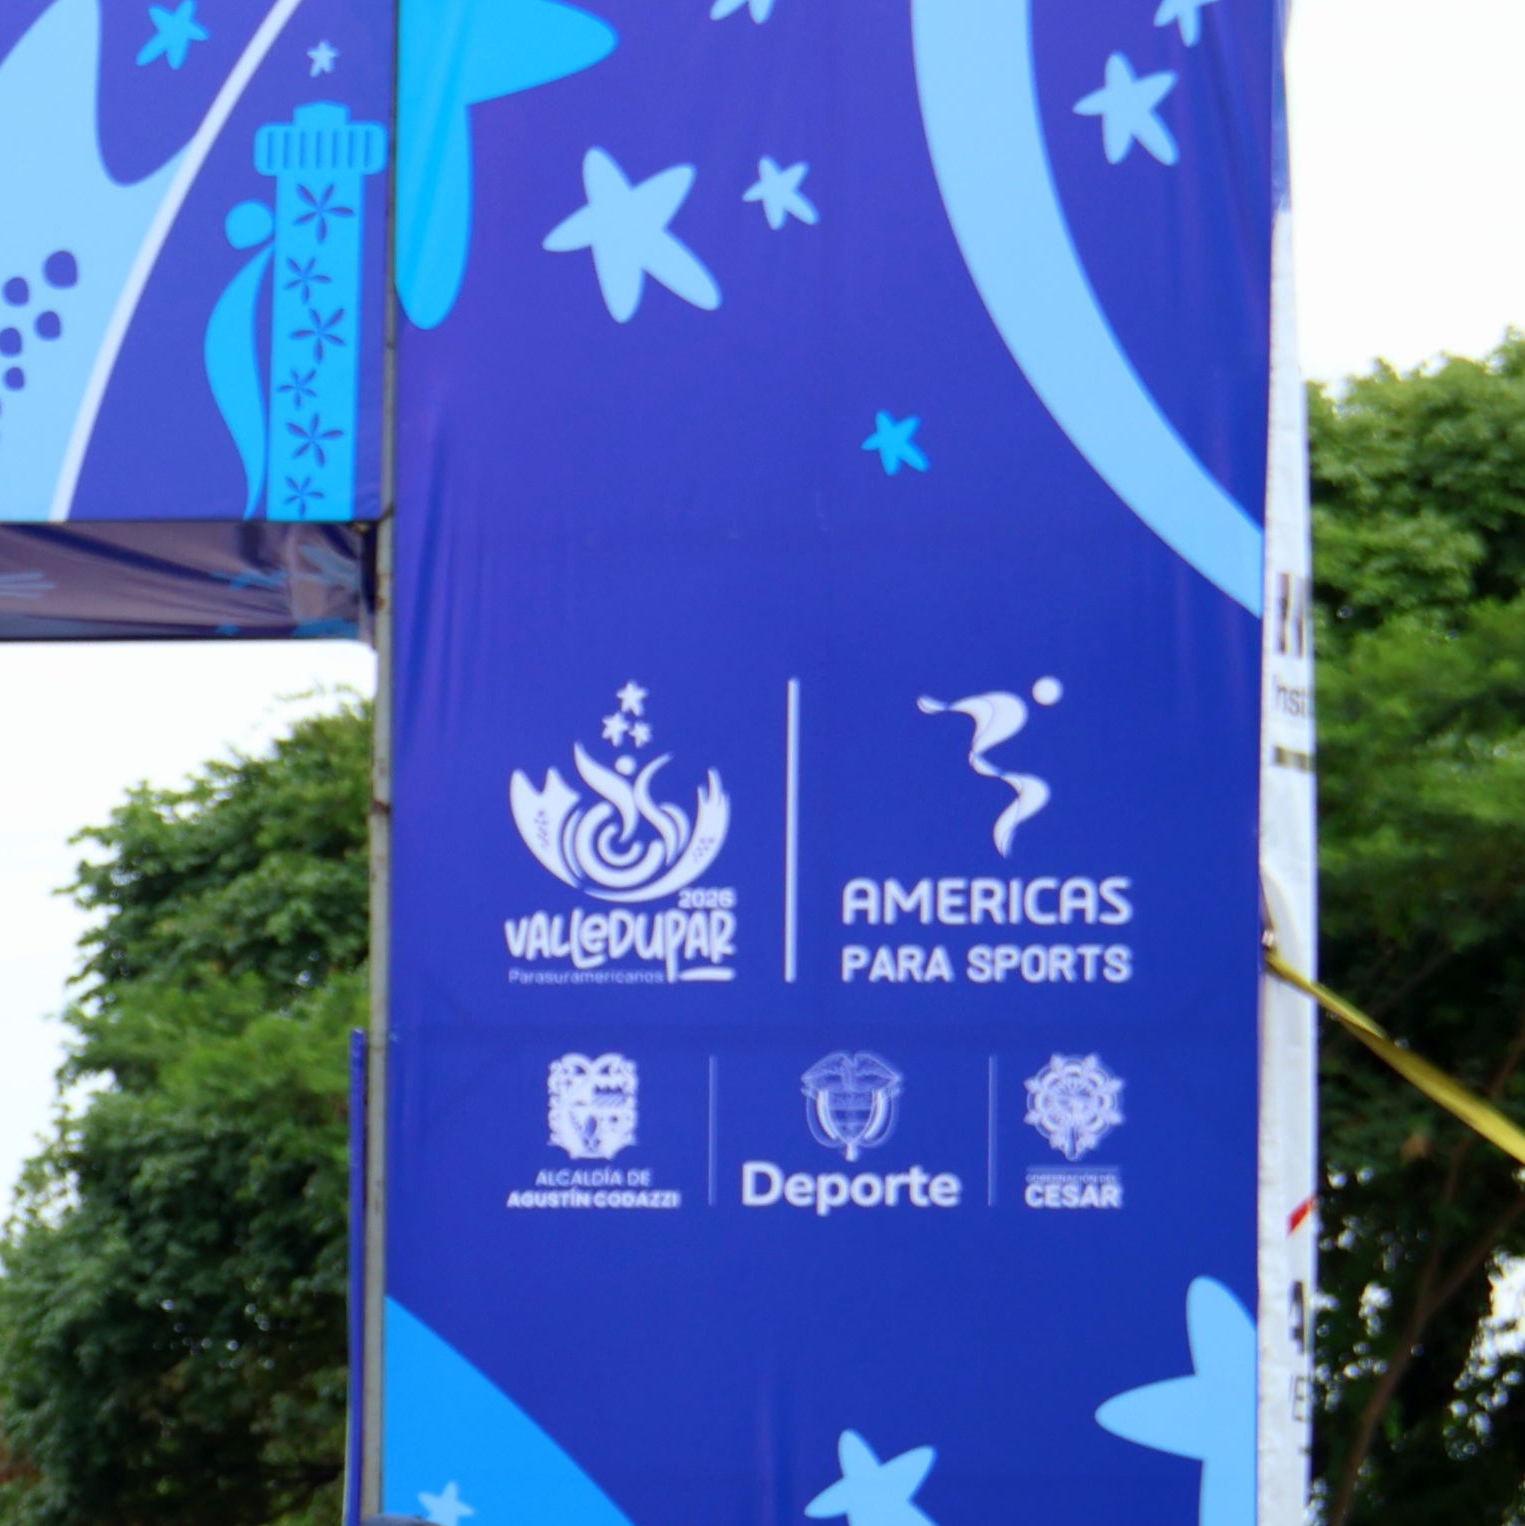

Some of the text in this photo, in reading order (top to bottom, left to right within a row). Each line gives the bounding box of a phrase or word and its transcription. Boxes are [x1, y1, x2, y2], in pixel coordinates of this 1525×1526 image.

[678, 887, 736, 909] 2026
[842, 877, 1133, 926] AMERICAS
[842, 942, 1133, 983] PARA SPORTS
[508, 967, 664, 984] Parasuramericanos
[627, 1168, 652, 1186] DE
[741, 1161, 961, 1216] Deporte
[593, 1190, 681, 1208] CODAZZI
[1024, 1184, 1123, 1208] CESAR
